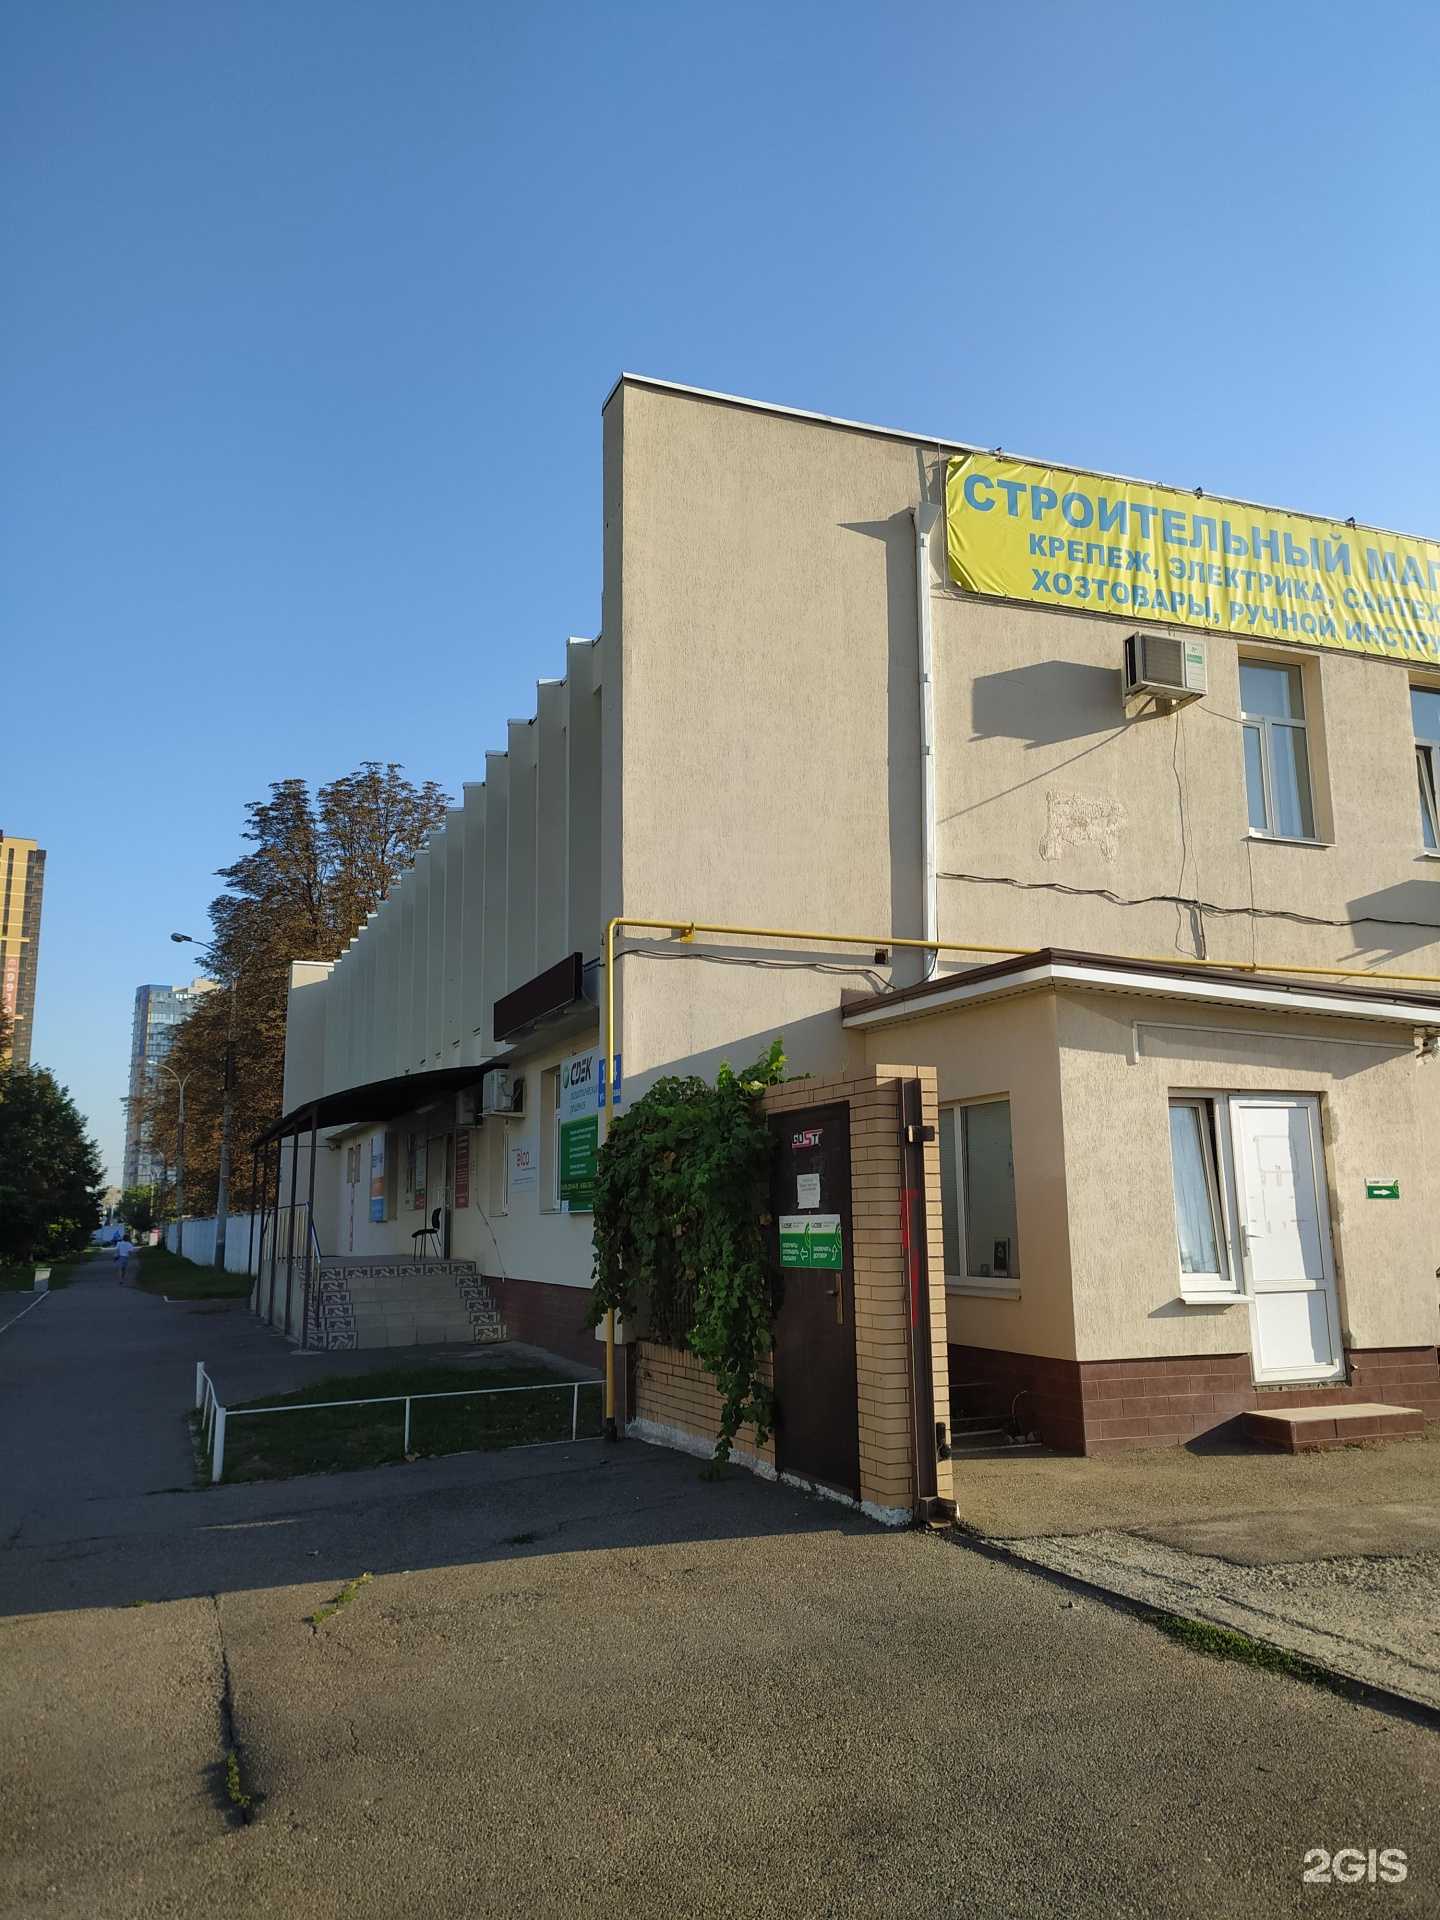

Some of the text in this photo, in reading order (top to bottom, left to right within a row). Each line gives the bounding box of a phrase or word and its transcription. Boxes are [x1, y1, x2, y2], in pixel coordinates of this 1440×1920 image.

[963, 472, 1352, 577] СТРОИТЕЛЬНЫЙ
[1028, 533, 1160, 580] КРЕПЕЖ,
[1168, 556, 1335, 610] ЭЛЕКТРИКА,
[1031, 567, 1220, 625] ХОЗТОВАРЫ,
[1229, 600, 1337, 641] РУЧНОЙ
[570, 1056, 593, 1086] CDEK
